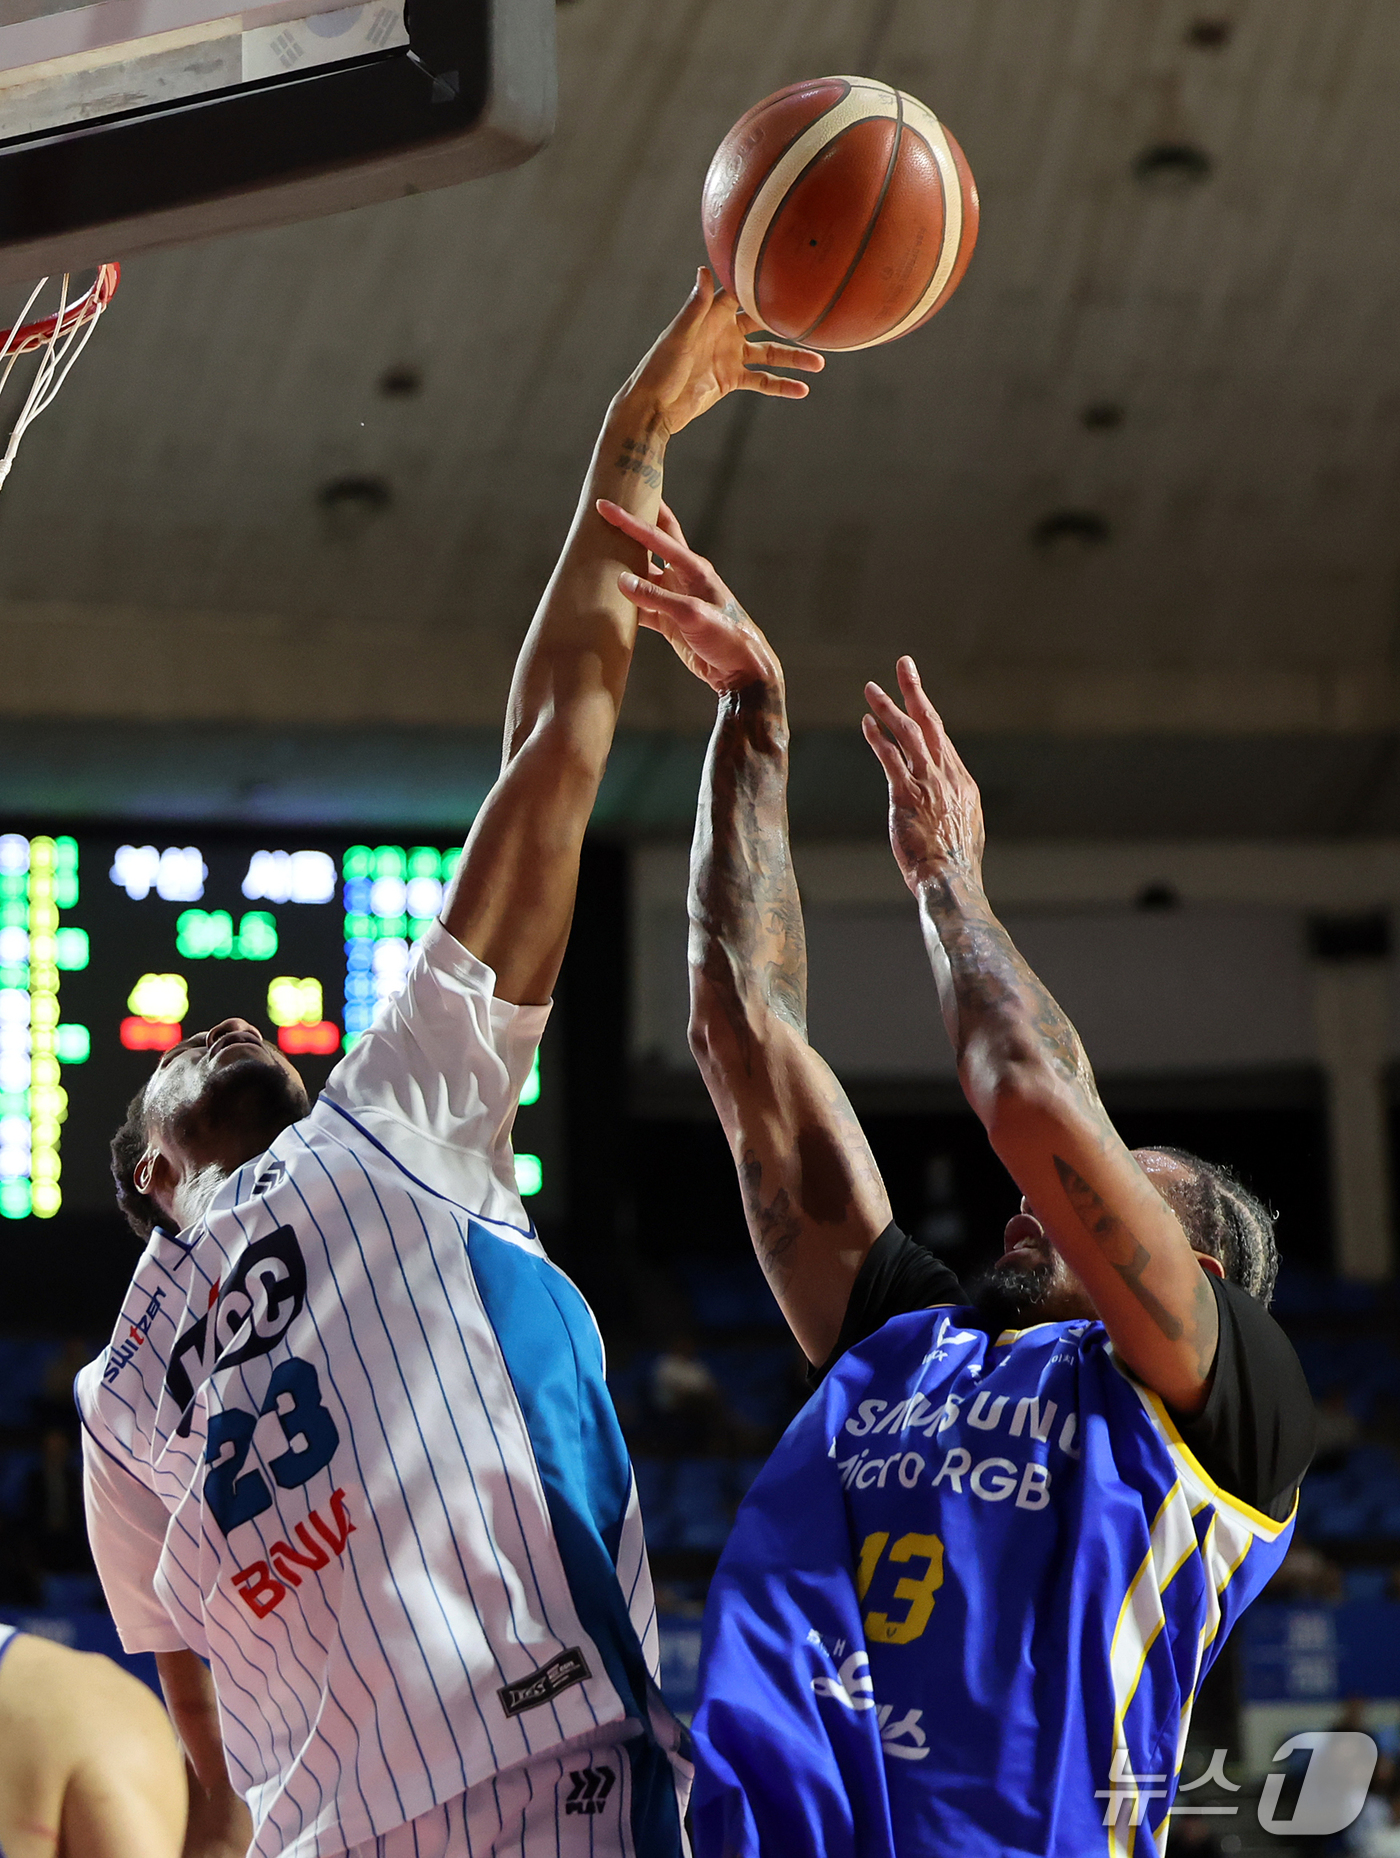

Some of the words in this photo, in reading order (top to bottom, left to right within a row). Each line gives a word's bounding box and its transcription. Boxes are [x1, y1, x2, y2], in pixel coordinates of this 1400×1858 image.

[203, 1356, 340, 1539] 23
[931, 1447, 1053, 1511] RGB
[856, 1530, 945, 1645] 13
[565, 1800, 606, 1815] PLAY
